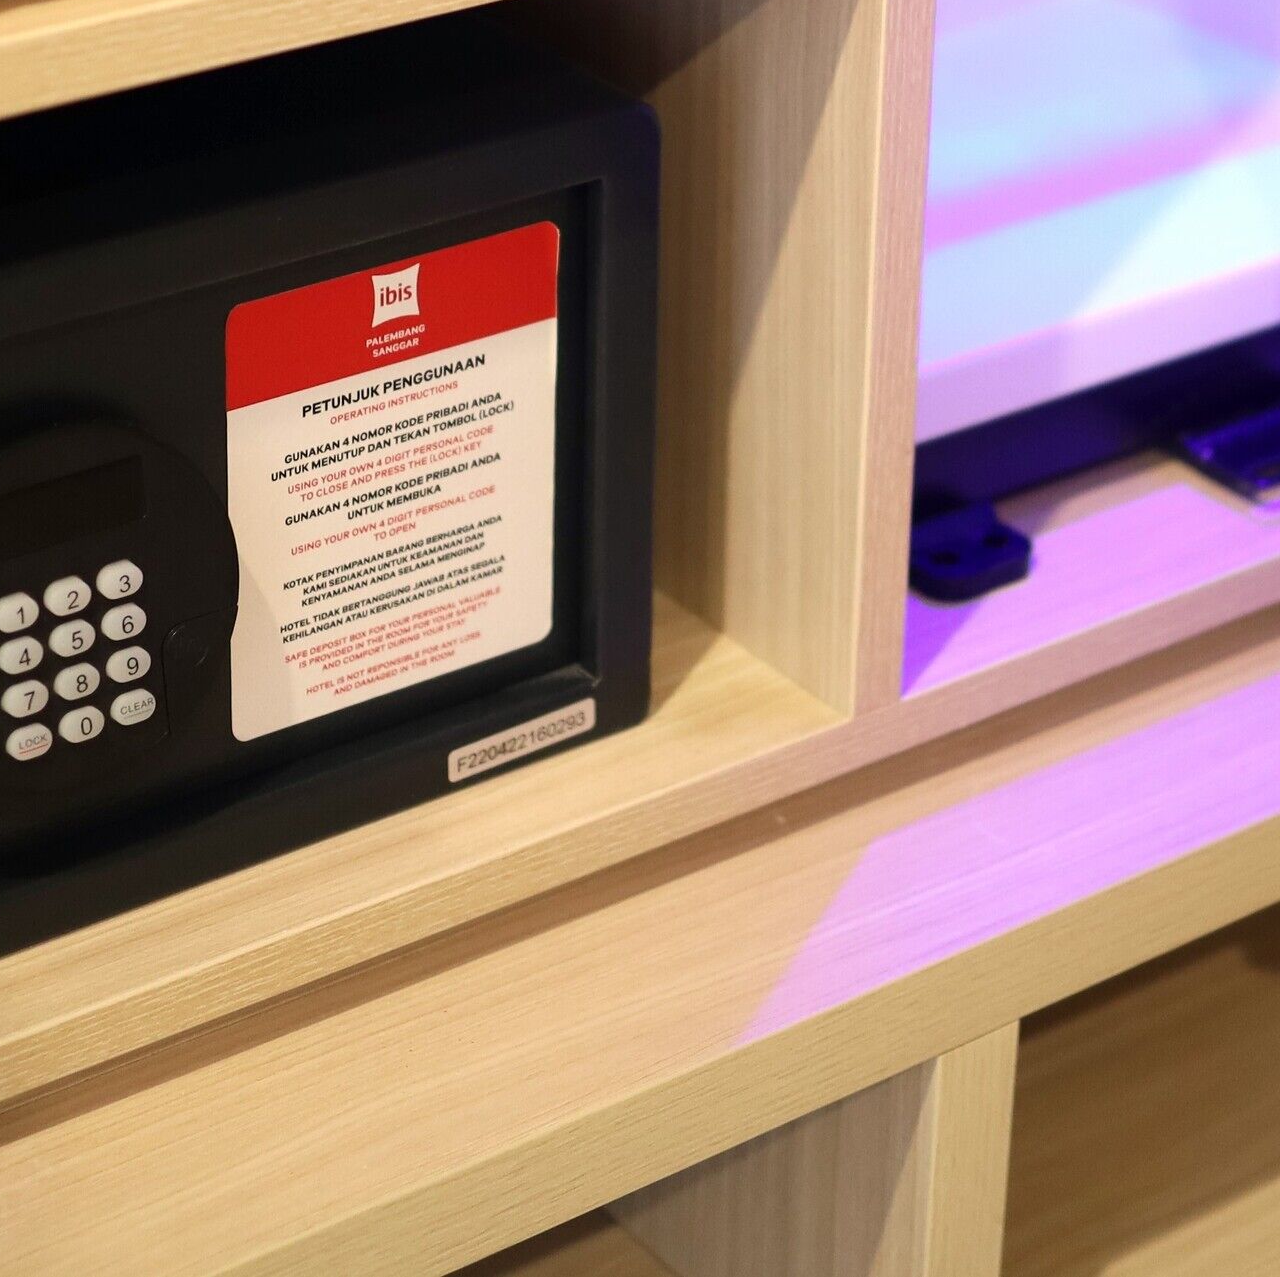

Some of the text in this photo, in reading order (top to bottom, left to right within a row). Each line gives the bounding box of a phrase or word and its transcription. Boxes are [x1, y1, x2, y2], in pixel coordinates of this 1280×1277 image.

[379, 282, 413, 307] ibis
[366, 324, 425, 348] PALEMBANG
[373, 338, 420, 358] SANGGAR
[302, 353, 485, 417] PETUNJUK PENGGUNAAN
[330, 380, 458, 424] OPERATING INSTRUCTIONS
[284, 391, 501, 463] GUNAKAN 4 NOMOR KODE PRIBADI ANDA
[271, 400, 514, 481] UNTUK MENUTUP DAN TEKAN TOMBOL (LOCK)
[287, 424, 493, 494] USING YOUR OWN 4 DIGIT PERSONAL CODE
[300, 440, 481, 502] TO CLOSE AND PRESS THE (LOCK) KEY
[285, 451, 500, 526] GUNAKAN 4 NOMOR KODE PRIBADI ANDA
[347, 483, 441, 520] UNTUK MEMBUKA
[290, 484, 495, 555] USING YOUR OWN 4 DIGIT PERSONAL CODE
[374, 521, 416, 541] TO OPEN
[283, 574, 313, 590] KOTAK
[315, 551, 383, 580] PENYIMPANAN
[386, 539, 424, 557] BARANG
[476, 514, 502, 528] ANDA
[303, 531, 483, 595] KAMI SEDIAKAN UNTUK KEAMANAN DAN
[119, 574, 131, 593] 3
[301, 541, 485, 607] KENYAMANAN ANDA SELAMA MENGINAP
[67, 591, 79, 610] 2
[280, 617, 310, 633] HOTEL
[312, 607, 339, 623] TIDAK
[342, 584, 410, 613] BERTANGGUNG
[413, 573, 444, 590] JAWAB
[446, 565, 468, 579] ATAS
[282, 565, 503, 643] KEHILANGAN ATAU KERUSAKAN DI DALAM KAMAR
[16, 606, 25, 624] 1
[122, 615, 134, 633] 6
[72, 630, 83, 650] 5
[19, 648, 31, 666] 4
[127, 656, 139, 675] 9
[76, 674, 89, 693] 8
[23, 691, 36, 711] 7
[120, 697, 154, 715] CLEAR
[80, 716, 93, 735] 0
[19, 733, 48, 750] LOCK
